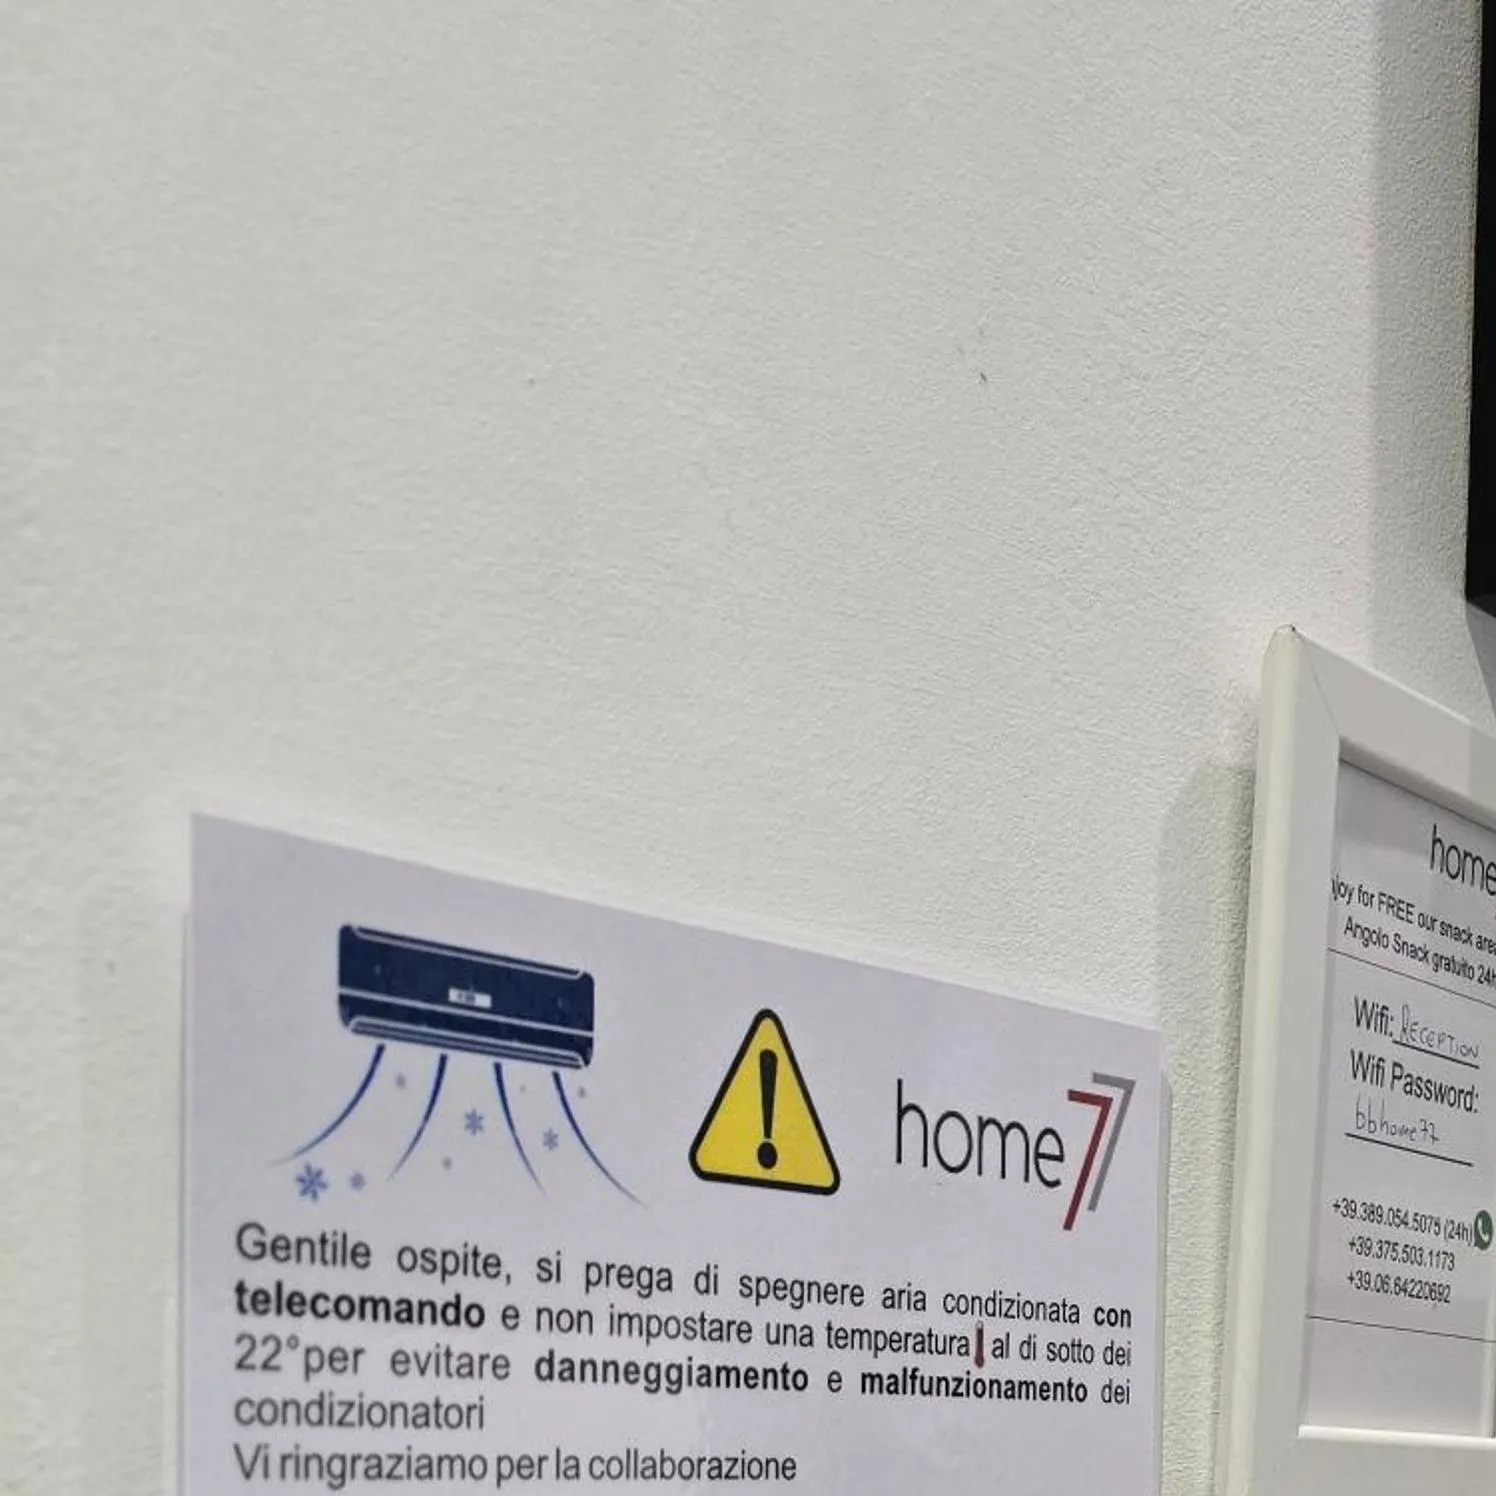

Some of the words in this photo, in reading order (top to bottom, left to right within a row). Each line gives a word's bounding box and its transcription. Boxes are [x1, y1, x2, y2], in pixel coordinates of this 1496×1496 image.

[1357, 884, 1375, 908] for
[1377, 892, 1416, 925] FREE
[1417, 912, 1438, 932] our
[1439, 920, 1473, 946] snack
[1344, 915, 1389, 949] Angolo
[1391, 932, 1430, 964] Snack
[1431, 951, 1475, 980] gratuito
[1354, 994, 1394, 1037] Wifi:
[1350, 1049, 1385, 1088] Wifi
[1390, 1062, 1478, 1113] Password:
[1348, 1236, 1455, 1271] +39.375.503.1173
[1444, 1219, 1473, 1247] (24h)
[235, 1221, 373, 1271] Gentile
[396, 1241, 512, 1286] ospite,
[535, 1249, 562, 1284] si
[584, 1260, 674, 1300] prega
[693, 1262, 719, 1297] di
[738, 1273, 865, 1311] spegnere
[880, 1281, 927, 1313] aria
[942, 1289, 1081, 1325] condizionata
[1092, 1305, 1132, 1330] con
[233, 1279, 486, 1330] telecomando
[500, 1304, 521, 1332] e
[535, 1306, 594, 1336] non
[609, 1302, 753, 1347] impostare
[765, 1321, 815, 1348] una
[824, 1319, 971, 1360] temperatura
[990, 1331, 1011, 1360] al
[1018, 1333, 1037, 1362] di
[1046, 1337, 1096, 1366] sotto
[1102, 1339, 1132, 1368] dei
[389, 1343, 512, 1382] evitare
[534, 1347, 809, 1396] danneggiamento
[826, 1369, 843, 1394] e
[860, 1365, 1089, 1404] malfunzionamento
[1100, 1377, 1131, 1406] dei
[234, 1390, 485, 1431] condizionatori
[232, 1443, 270, 1481] Vi
[279, 1444, 489, 1492] ringraziamo
[495, 1453, 550, 1490] per
[555, 1445, 581, 1482] la
[587, 1447, 797, 1482] collaborazione
